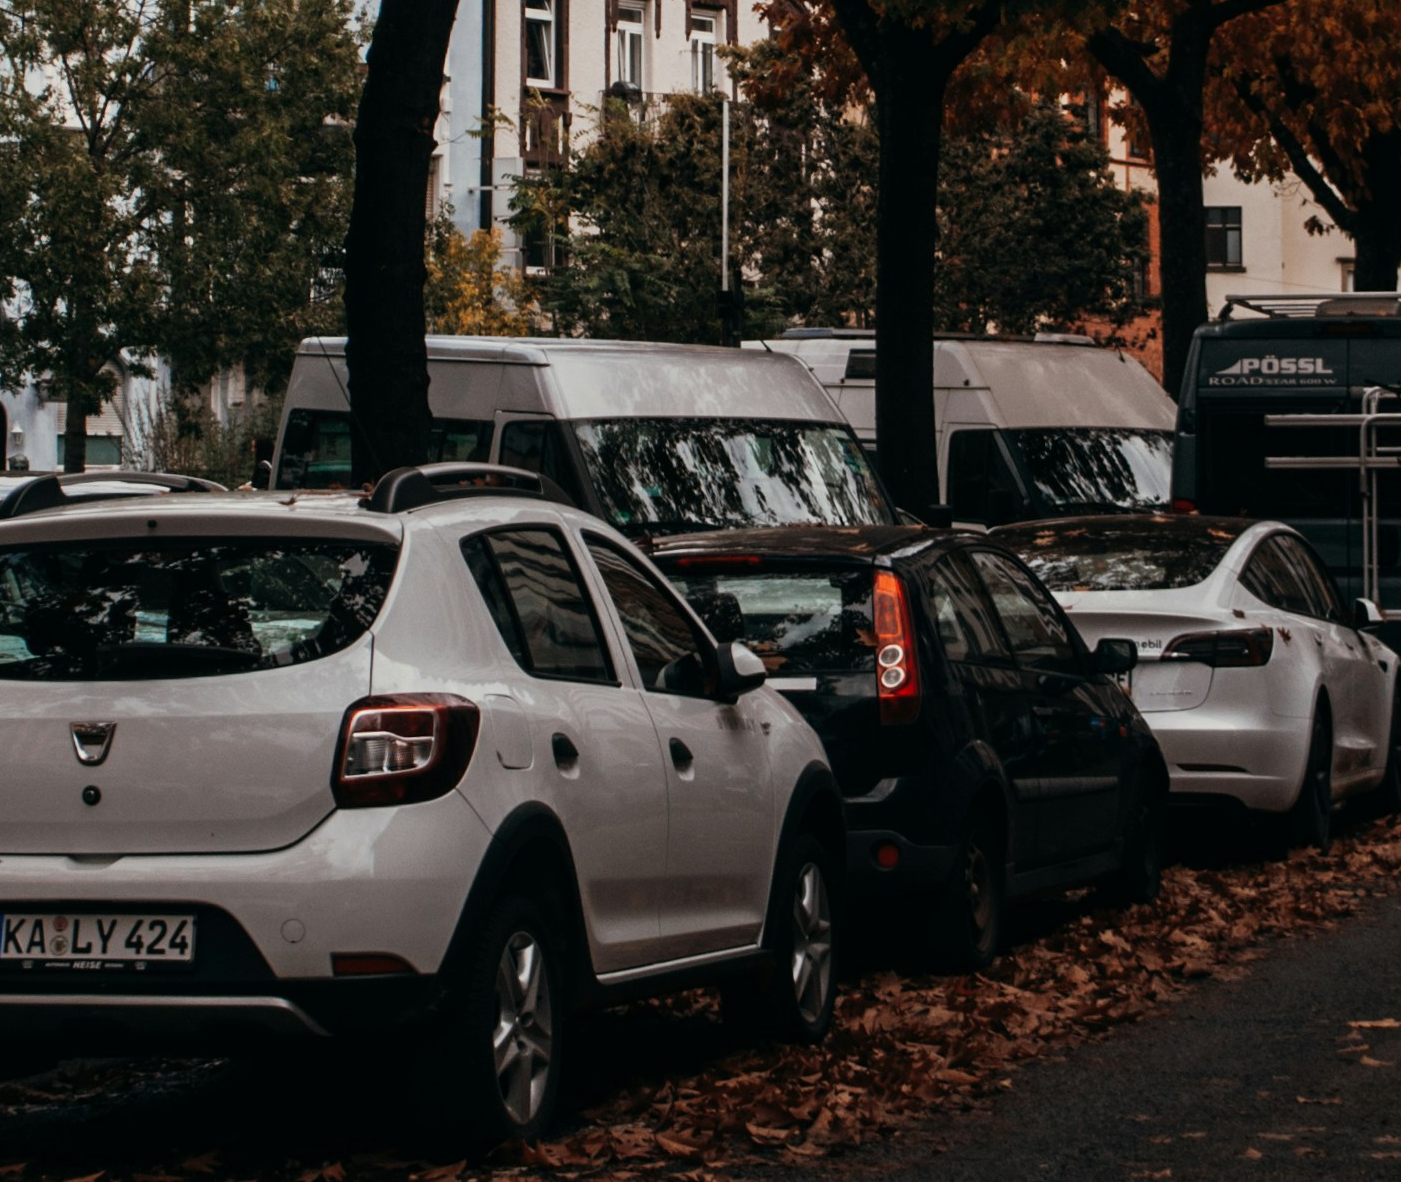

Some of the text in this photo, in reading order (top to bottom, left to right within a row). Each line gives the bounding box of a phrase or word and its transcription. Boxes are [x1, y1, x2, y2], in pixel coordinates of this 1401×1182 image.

[1242, 355, 1333, 374] PÖSSL
[3, 919, 45, 954] KA
[71, 919, 117, 954] LY
[124, 919, 189, 955] 424
